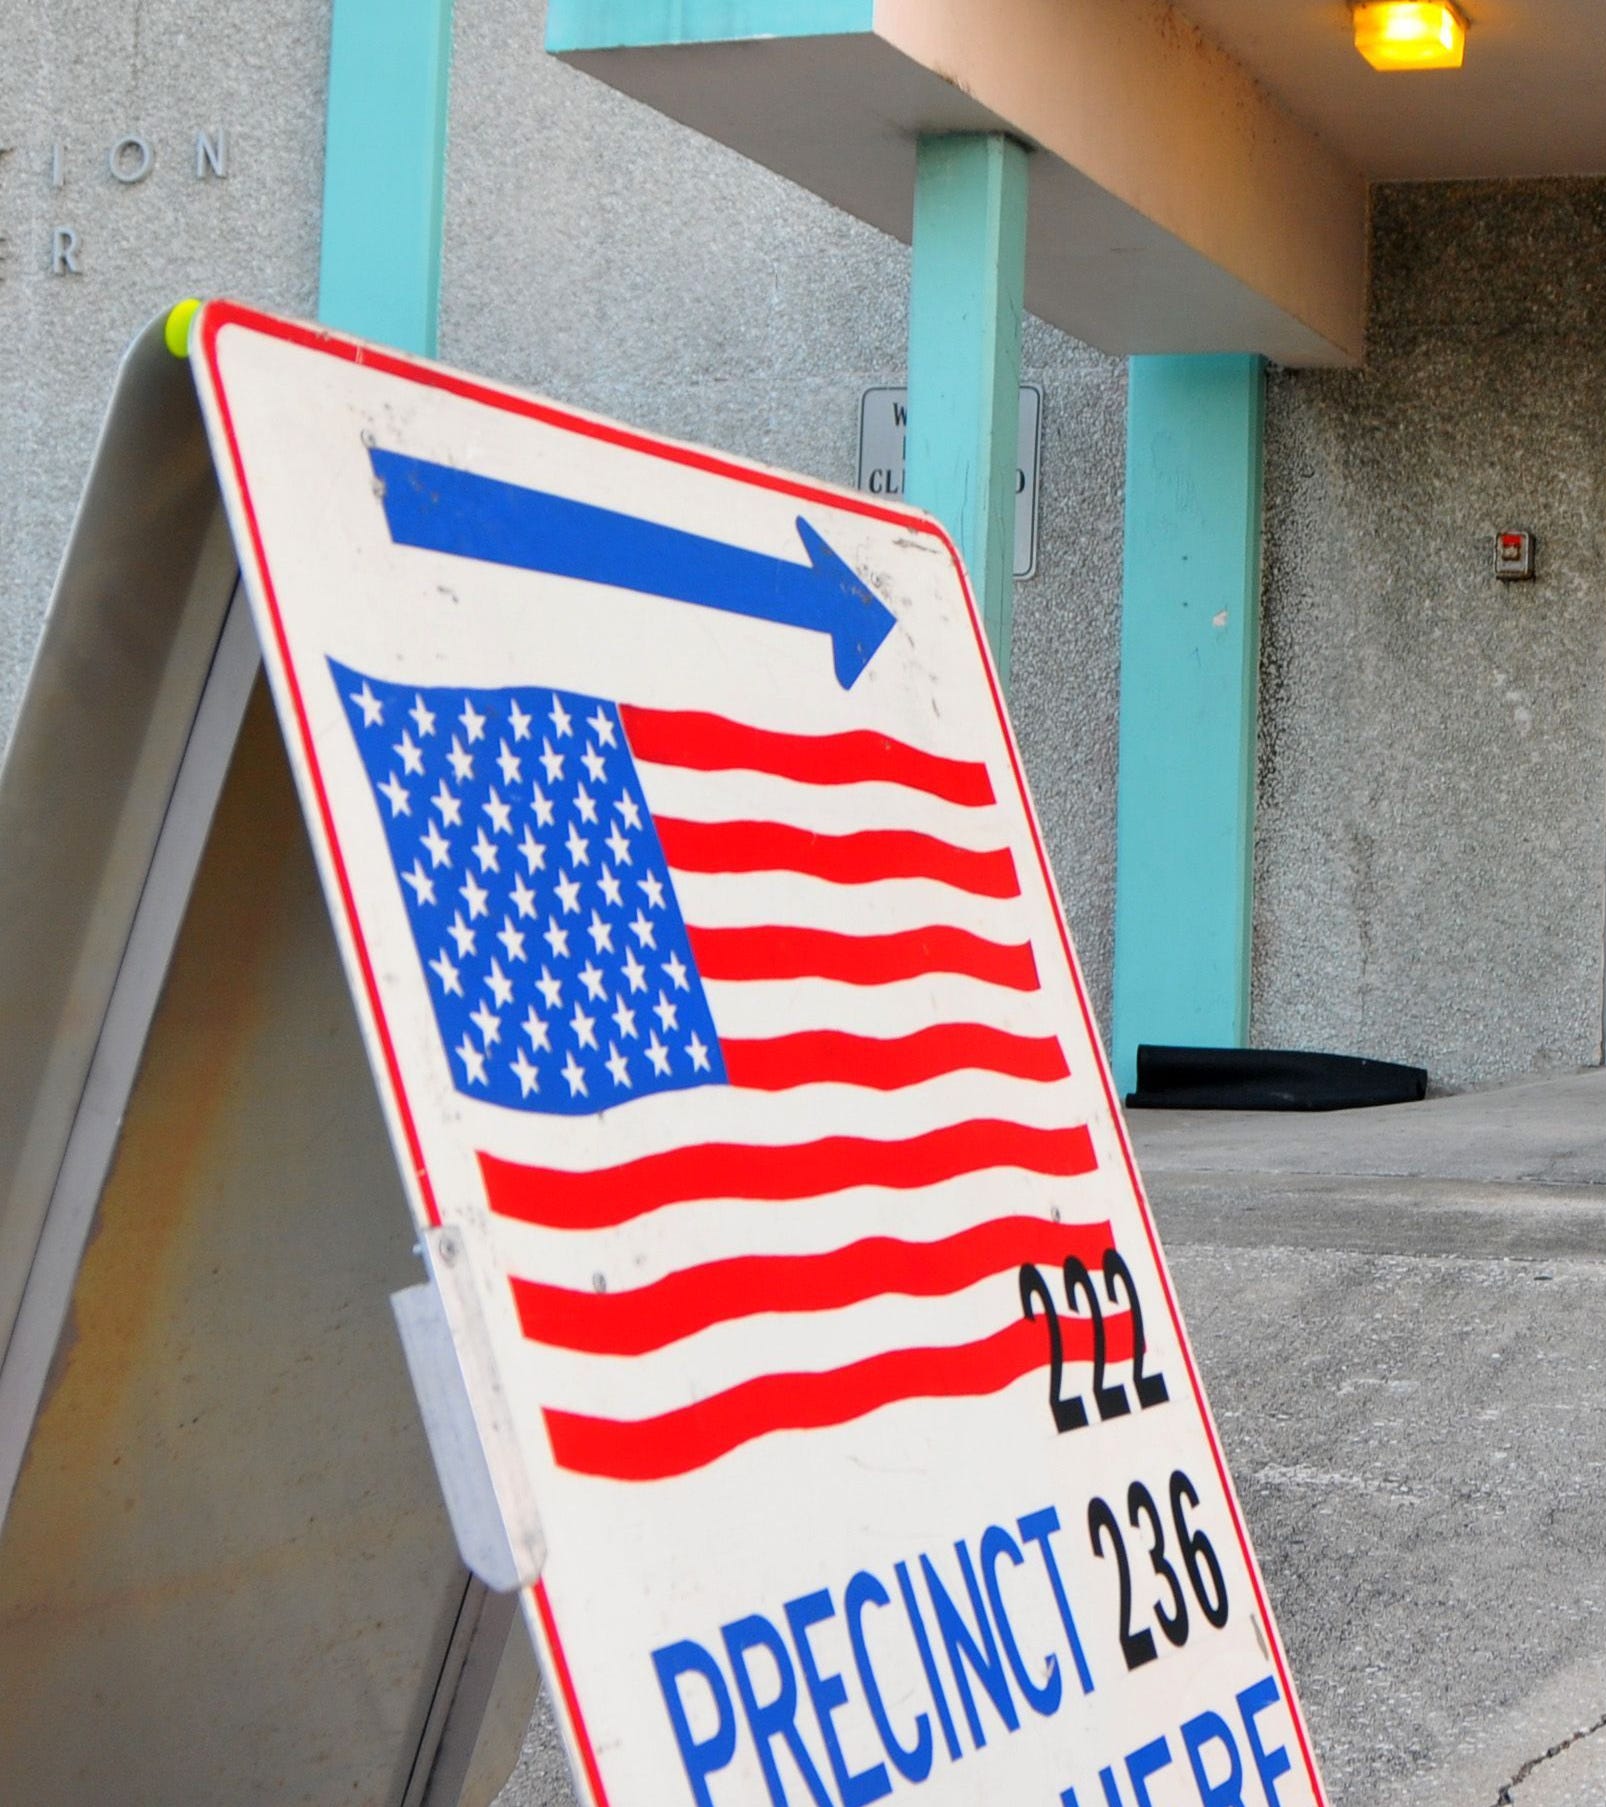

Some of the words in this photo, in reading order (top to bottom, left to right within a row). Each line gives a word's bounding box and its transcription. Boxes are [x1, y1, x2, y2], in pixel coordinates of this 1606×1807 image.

[0, 128, 229, 188] ION
[1018, 1249, 1170, 1434] 222
[651, 1505, 1095, 1807] PRECINCT
[1087, 1469, 1229, 1672] 236
[1060, 1675, 1291, 1807] RE
